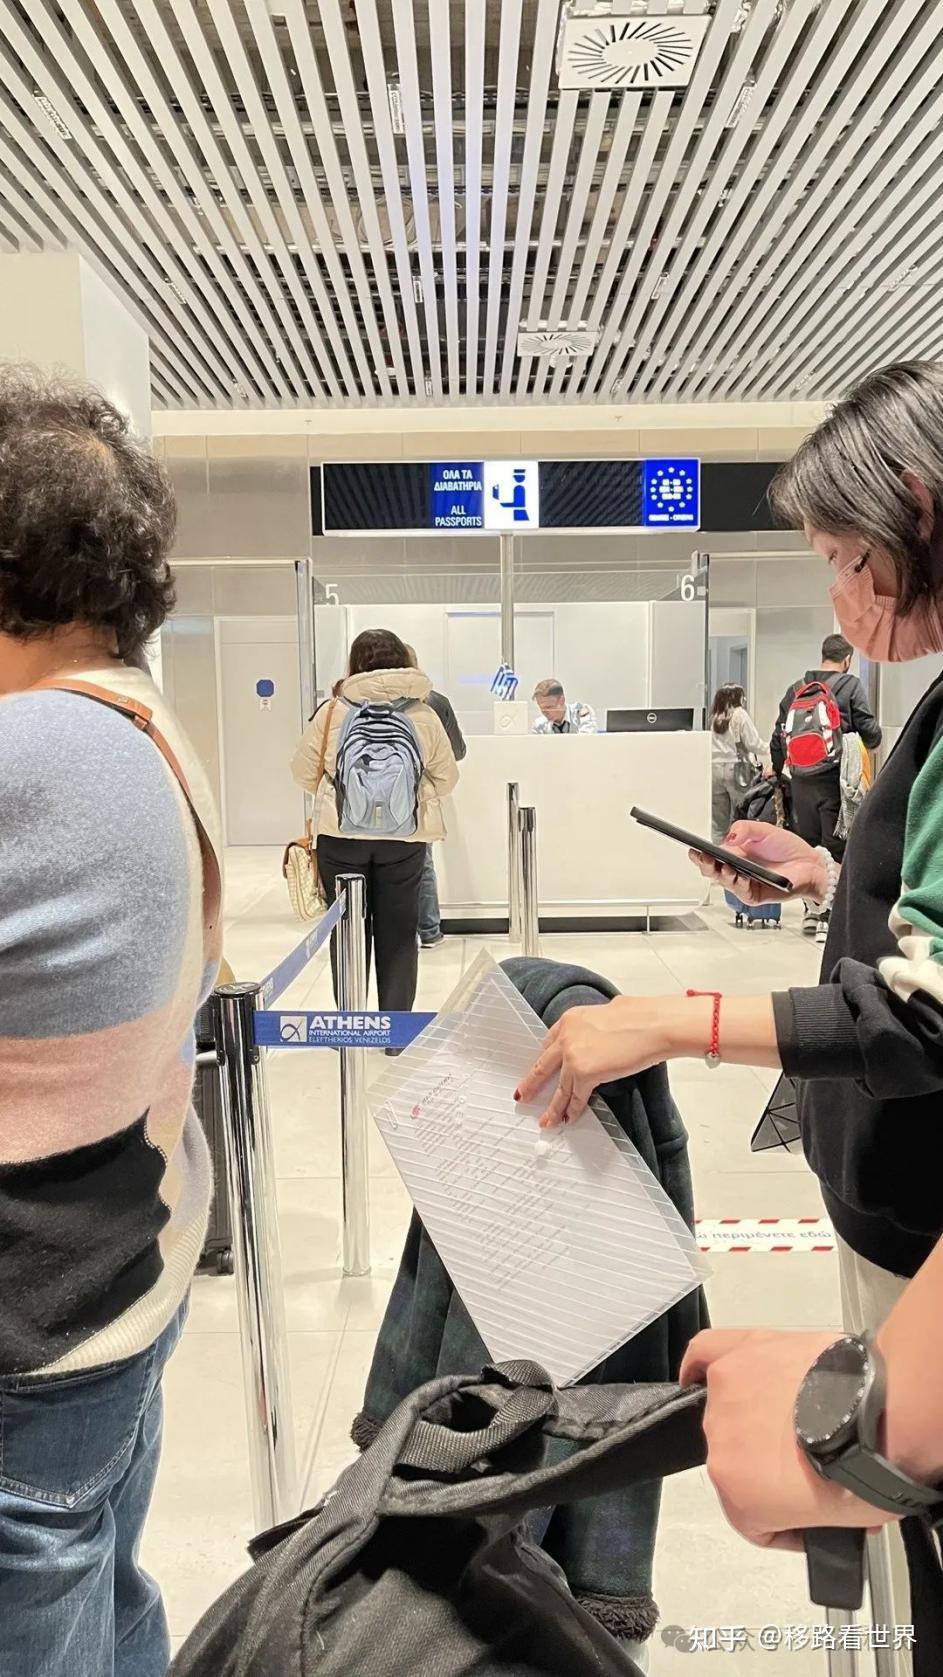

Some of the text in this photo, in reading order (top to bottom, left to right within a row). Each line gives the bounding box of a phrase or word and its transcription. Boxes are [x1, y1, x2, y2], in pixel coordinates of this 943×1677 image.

[443, 470, 472, 479] ΟΛΑ ΤΑ
[434, 481, 482, 491] ΔΙΑΒΑΤΗΡΙΑ
[451, 505, 466, 515] ALL
[435, 517, 482, 526] PASSPORTS
[681, 574, 694, 601] 6
[325, 583, 339, 607] 5
[310, 1016, 391, 1029] ATHENS
